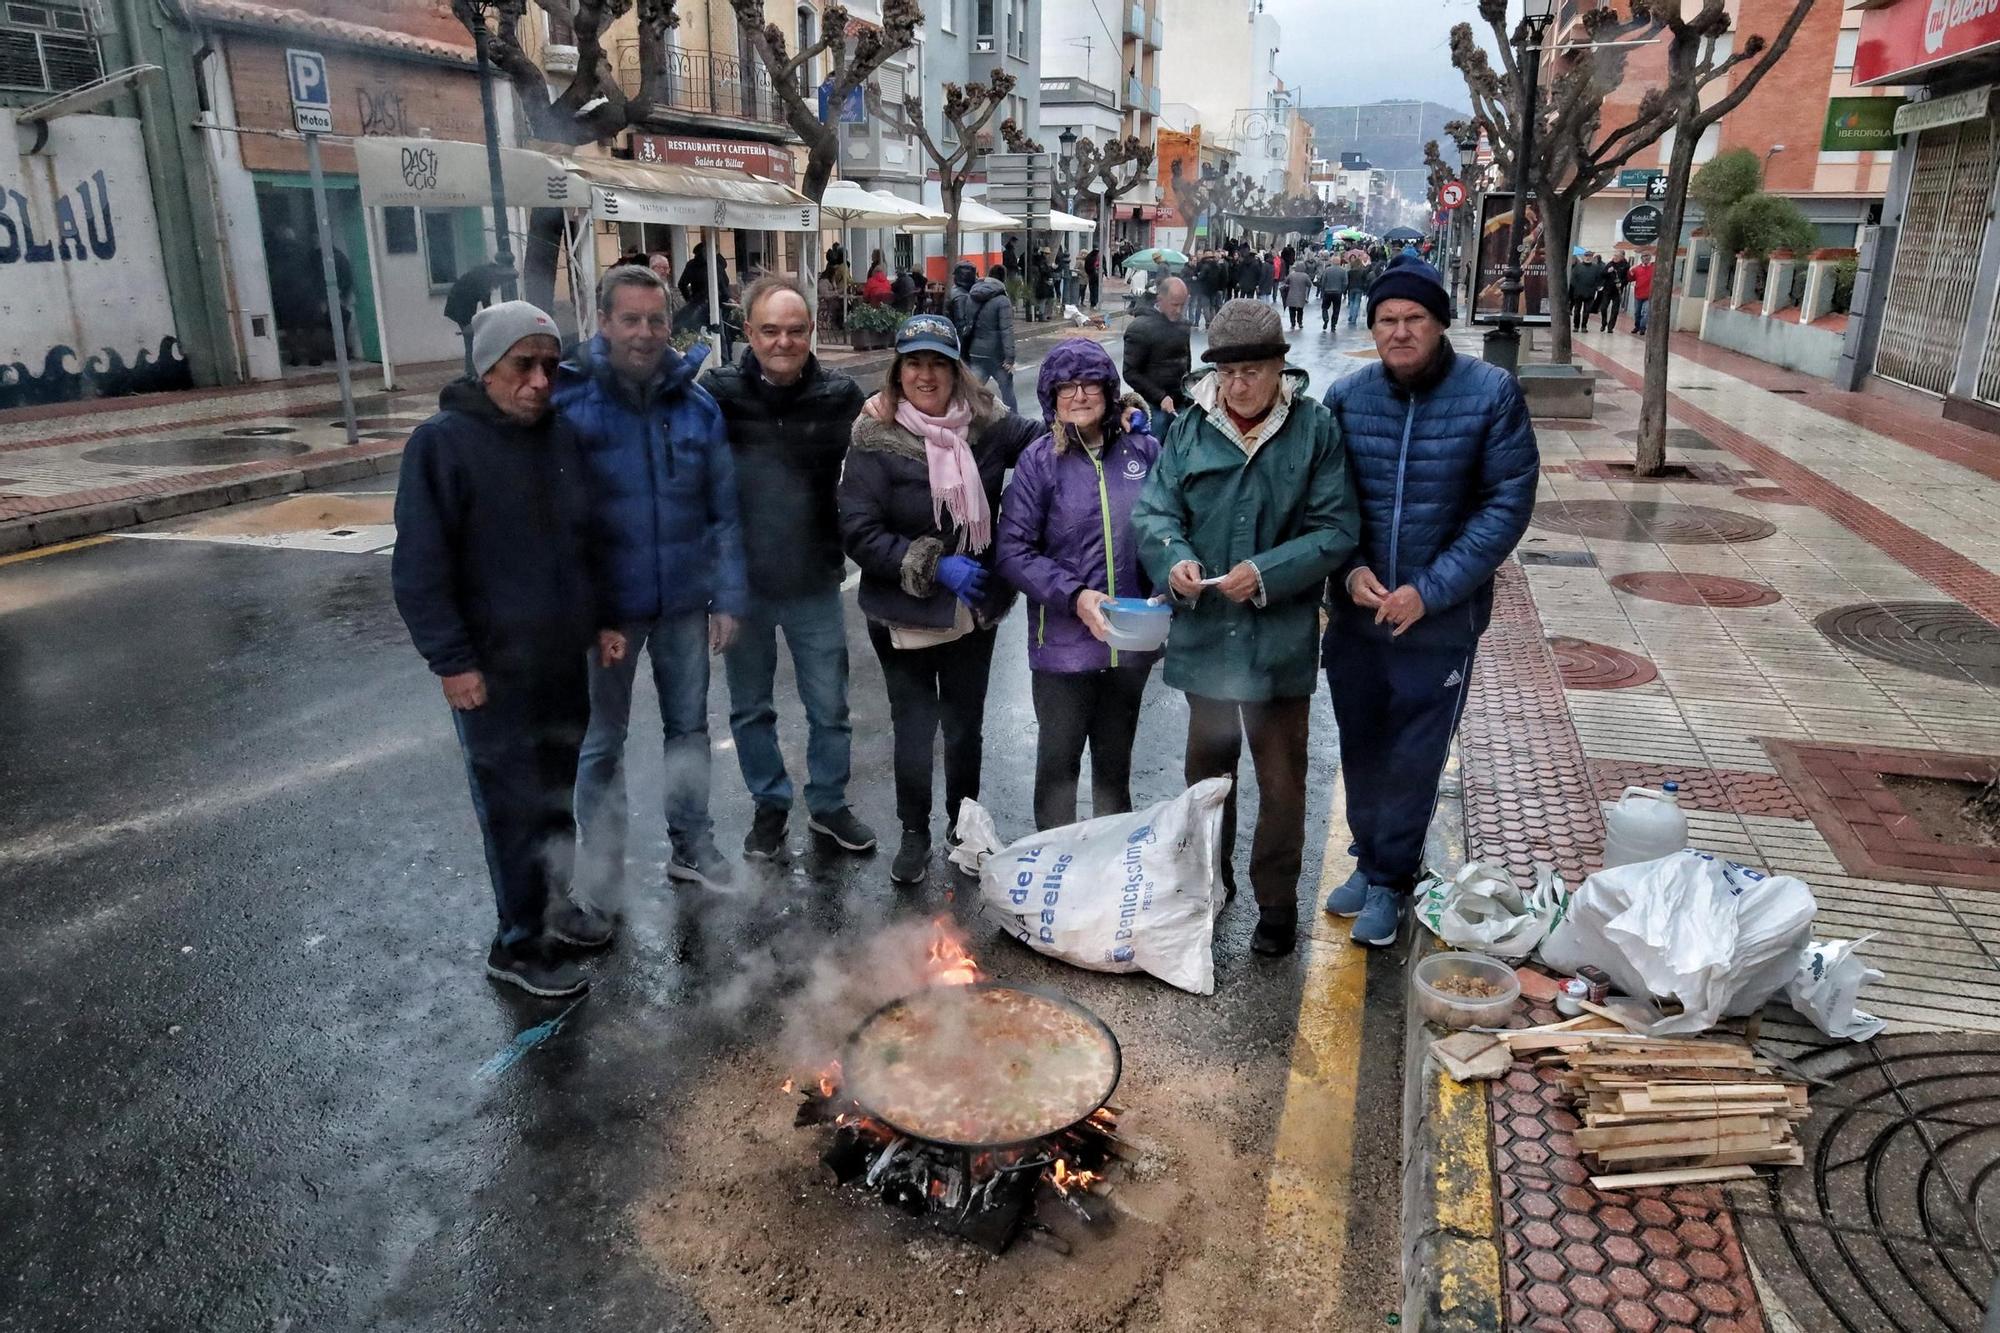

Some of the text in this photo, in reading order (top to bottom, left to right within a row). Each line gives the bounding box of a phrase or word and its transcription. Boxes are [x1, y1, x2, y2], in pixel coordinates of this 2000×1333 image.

[295, 56, 320, 100] P
[300, 114, 330, 127] Motos
[1838, 129, 1891, 138] IBERDROLA
[667, 140, 721, 152] RESTAURANTE
[722, 144, 727, 153] Y
[728, 143, 767, 156] CAFETERÍA
[715, 157, 723, 167] de
[1008, 871, 1033, 905] de
[1040, 854, 1073, 944] paellas
